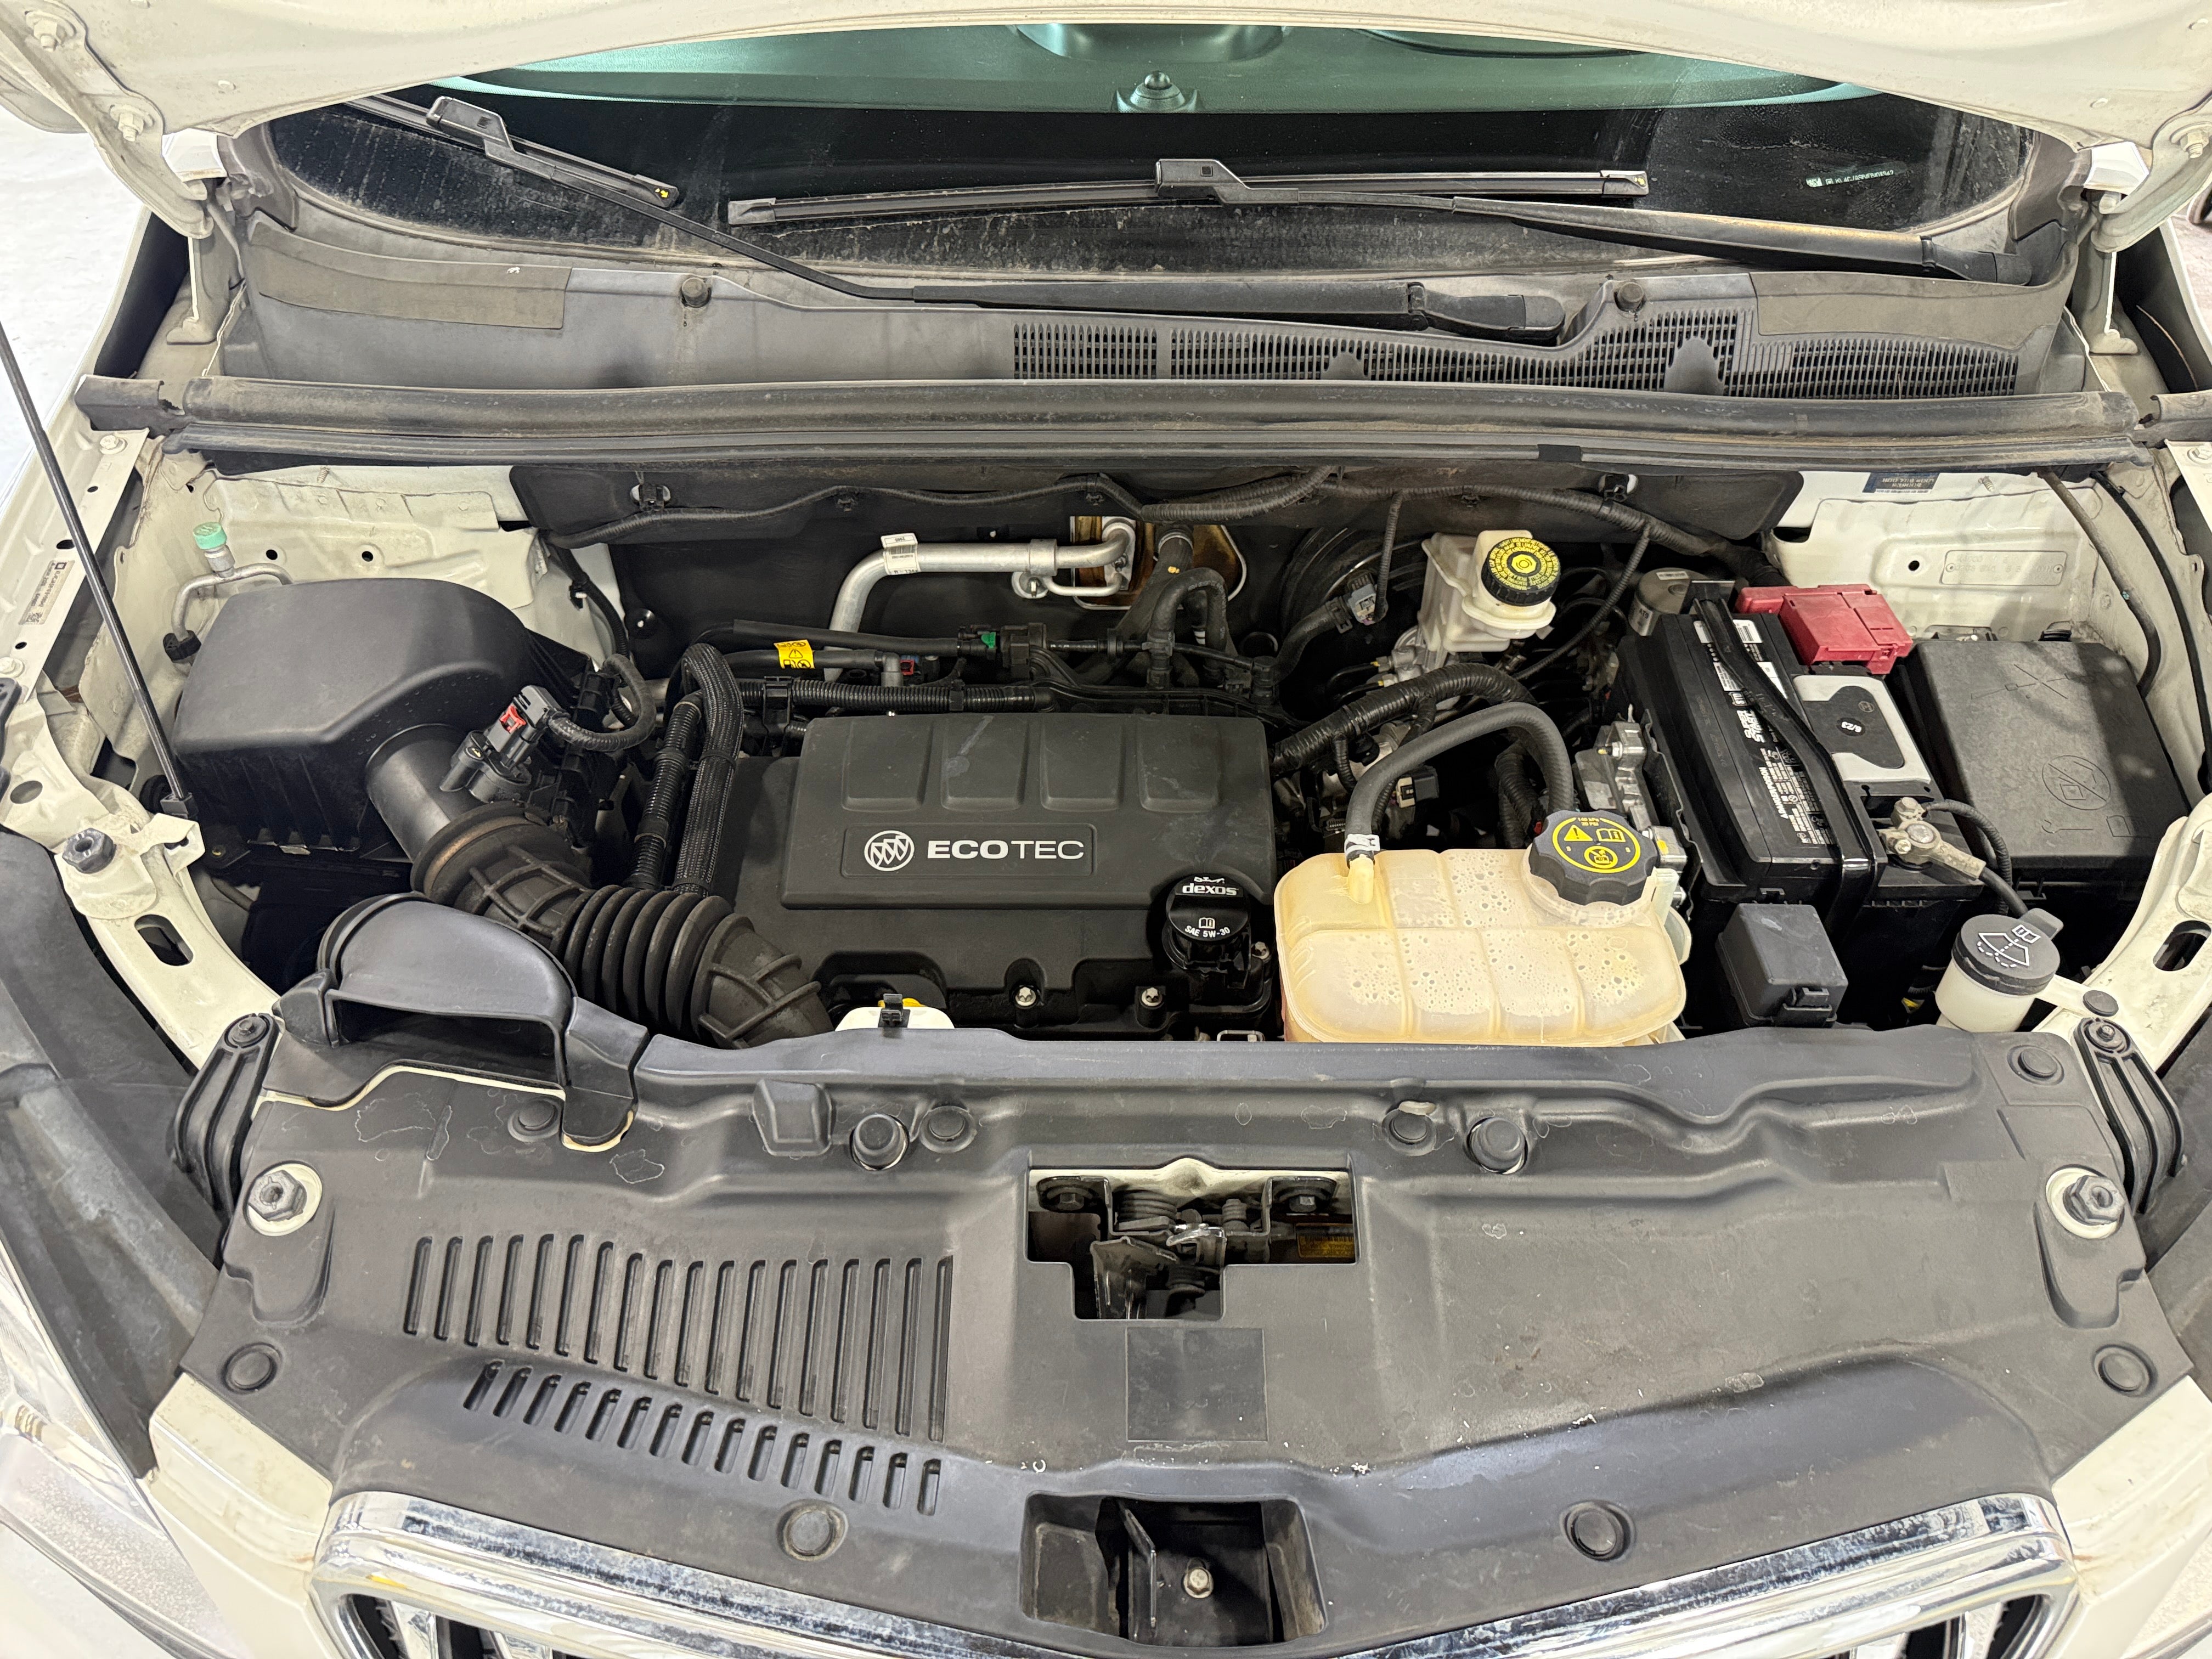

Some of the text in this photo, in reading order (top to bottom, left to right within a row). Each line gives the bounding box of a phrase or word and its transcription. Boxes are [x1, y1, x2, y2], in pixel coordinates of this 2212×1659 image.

[1737, 710, 1753, 738] SUPER
[1841, 721, 1862, 733] 6/23
[927, 840, 1085, 860] ECOTEC
[1182, 883, 1238, 896] dexos
[1184, 924, 1231, 938] SAE 5W-30
